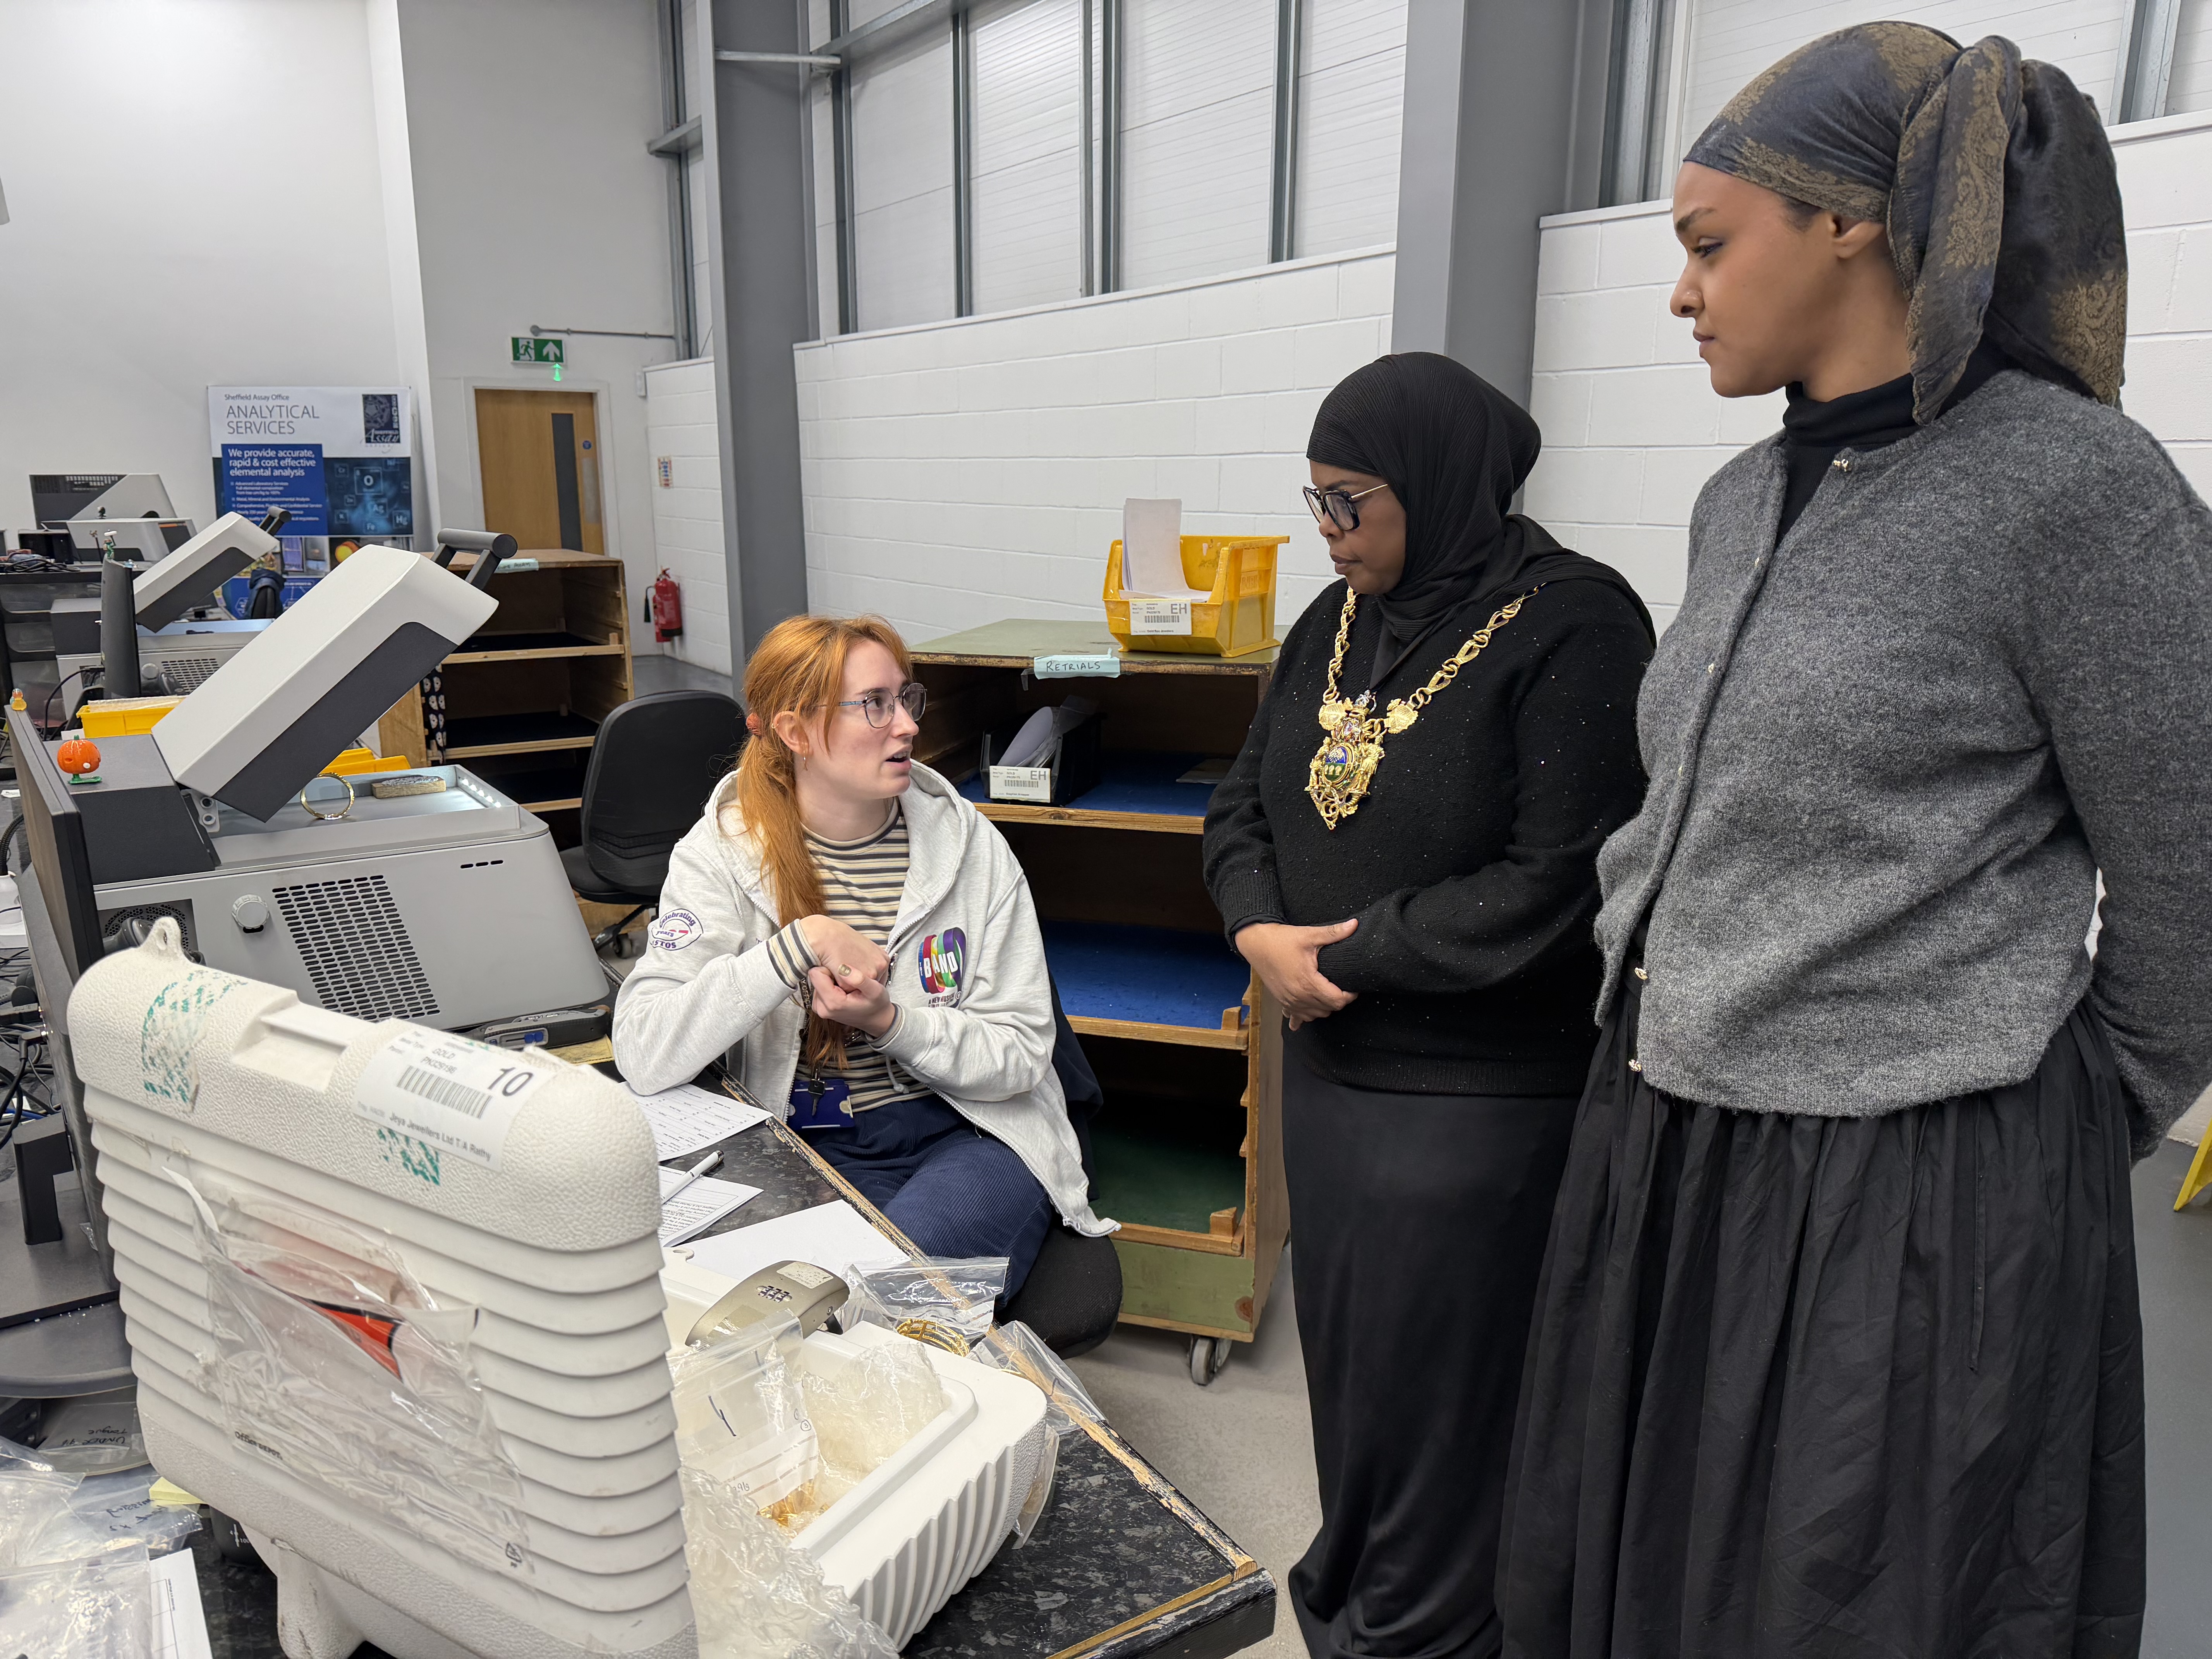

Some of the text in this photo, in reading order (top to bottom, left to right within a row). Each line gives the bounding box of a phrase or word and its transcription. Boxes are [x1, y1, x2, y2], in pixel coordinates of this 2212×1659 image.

[227, 405, 319, 419] ANALYTICAL
[227, 421, 295, 434] SERVICES
[228, 448, 314, 459] We provide accurate,
[229, 458, 251, 468] rapid
[252, 459, 259, 467] &
[280, 458, 316, 467] effective
[230, 467, 305, 478] elemental analysis
[364, 475, 374, 486] O
[1171, 603, 1187, 614] EH
[1046, 660, 1101, 672] RETRIALS
[1030, 770, 1046, 780] EH
[924, 951, 958, 978] BAND
[432, 1048, 456, 1059] GOLD
[488, 1066, 533, 1096] 10
[407, 1119, 440, 1139] Jewellers
[441, 1133, 454, 1145] Ltd
[235, 1431, 257, 1446] Office
